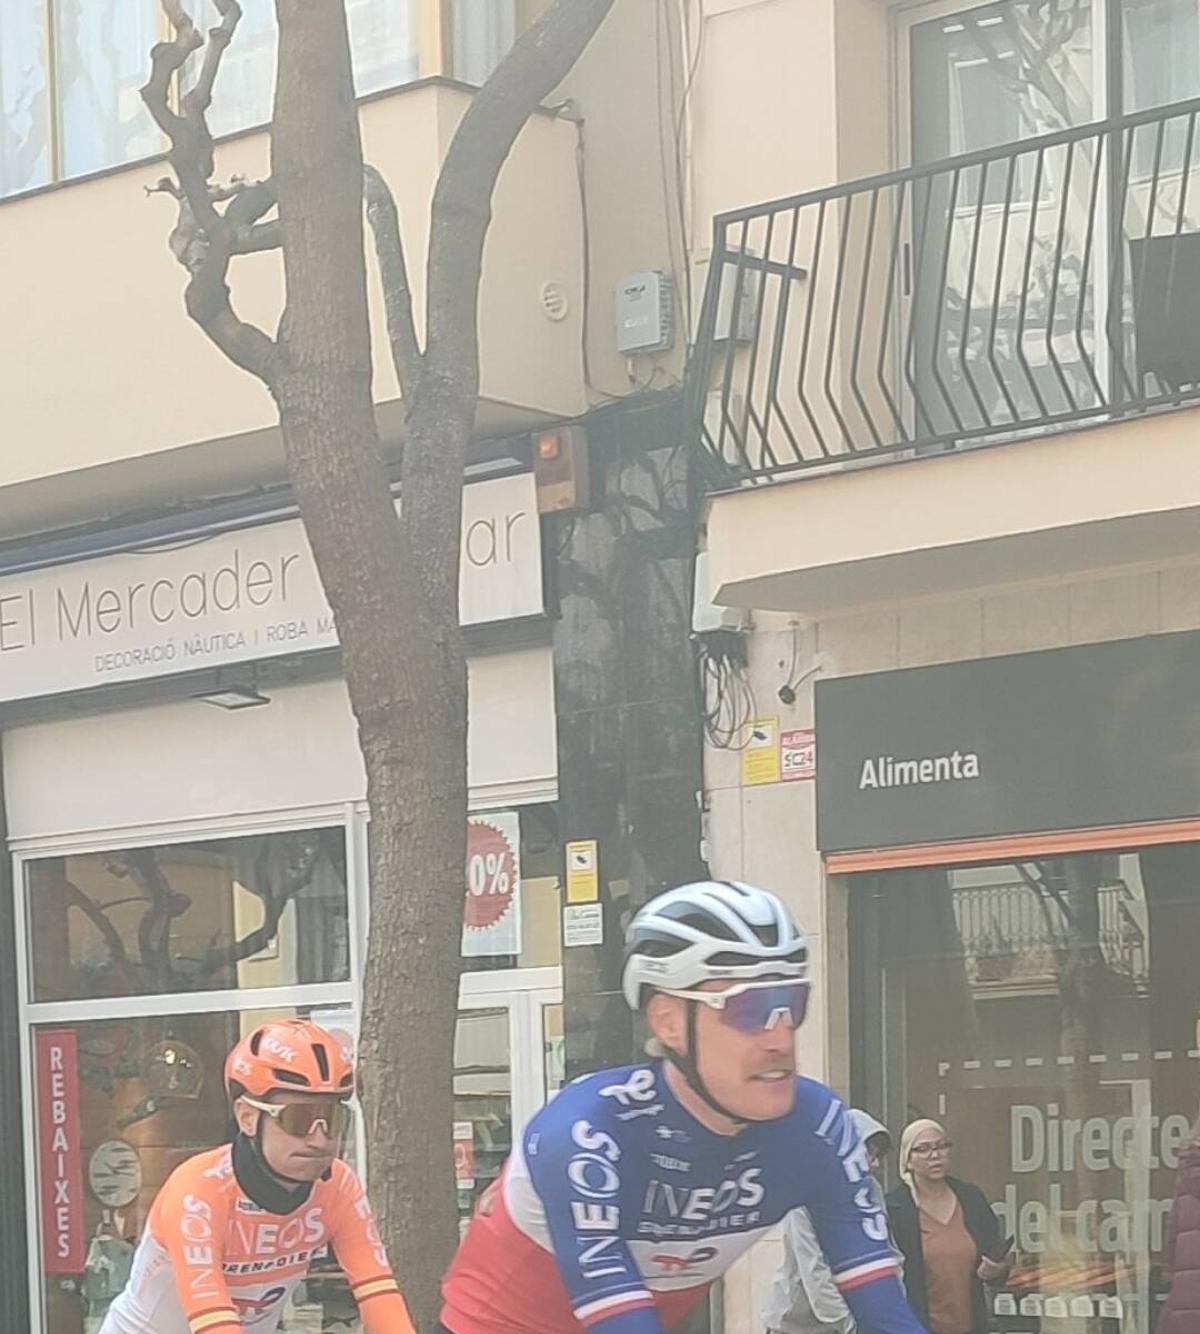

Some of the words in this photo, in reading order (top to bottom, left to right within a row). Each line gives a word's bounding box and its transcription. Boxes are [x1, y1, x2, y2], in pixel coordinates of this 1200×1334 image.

[0, 588, 36, 651] El
[57, 548, 300, 642] Mercader
[464, 511, 527, 567] ar
[95, 636, 177, 674] DECORACIÓ
[253, 629, 260, 645] I
[266, 619, 310, 643] ROBA
[316, 615, 337, 635] MA
[858, 750, 980, 790] Alimenta
[465, 852, 510, 897] 0%
[49, 1046, 71, 1259] REBAIXES
[1010, 1102, 1190, 1173] Directe
[567, 1119, 628, 1279] INEOS
[642, 1167, 765, 1220] INEOS
[989, 1183, 1062, 1253] del
[179, 1192, 220, 1299] INEOS
[224, 1207, 325, 1256] INEOS
